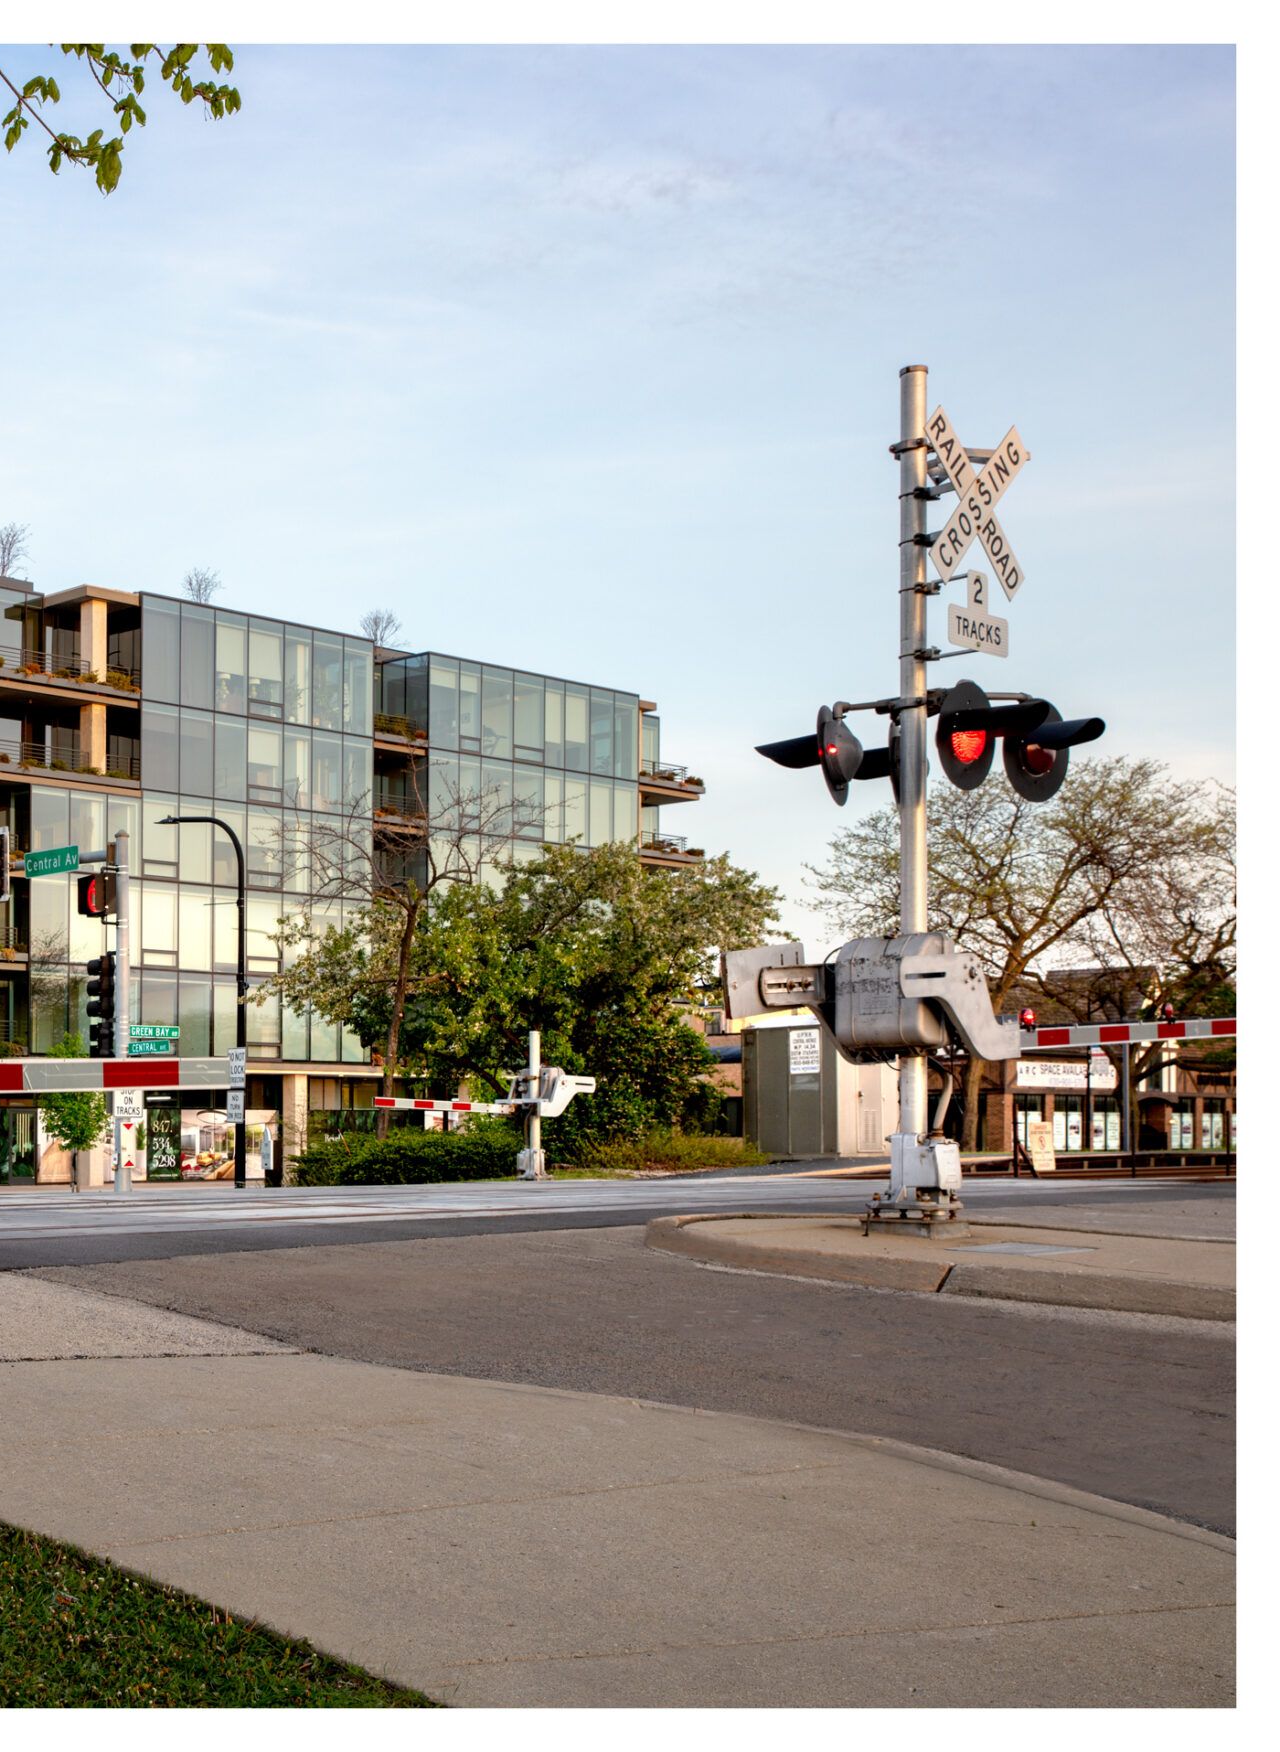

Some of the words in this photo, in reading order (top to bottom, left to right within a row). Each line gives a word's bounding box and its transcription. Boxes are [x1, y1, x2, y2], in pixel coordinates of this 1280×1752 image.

[930, 414, 967, 488] RAIL
[982, 518, 1019, 590] ROAD
[939, 441, 1020, 567] CROSSING
[973, 578, 983, 604] 2
[956, 616, 1002, 646] TRACKS
[26, 855, 61, 872] Central
[65, 852, 77, 866] Av
[131, 1027, 153, 1036] GREEN
[155, 1028, 170, 1037] BAY
[131, 1042, 157, 1053] CENTRAL
[235, 1052, 244, 1061] NOT
[230, 1065, 244, 1075] LOCK
[1040, 1064, 1061, 1075] SPACE
[123, 1096, 133, 1105] ON
[116, 1106, 140, 1116] TRACKS
[152, 1120, 173, 1133] 847.
[152, 1154, 177, 1168] 5298
